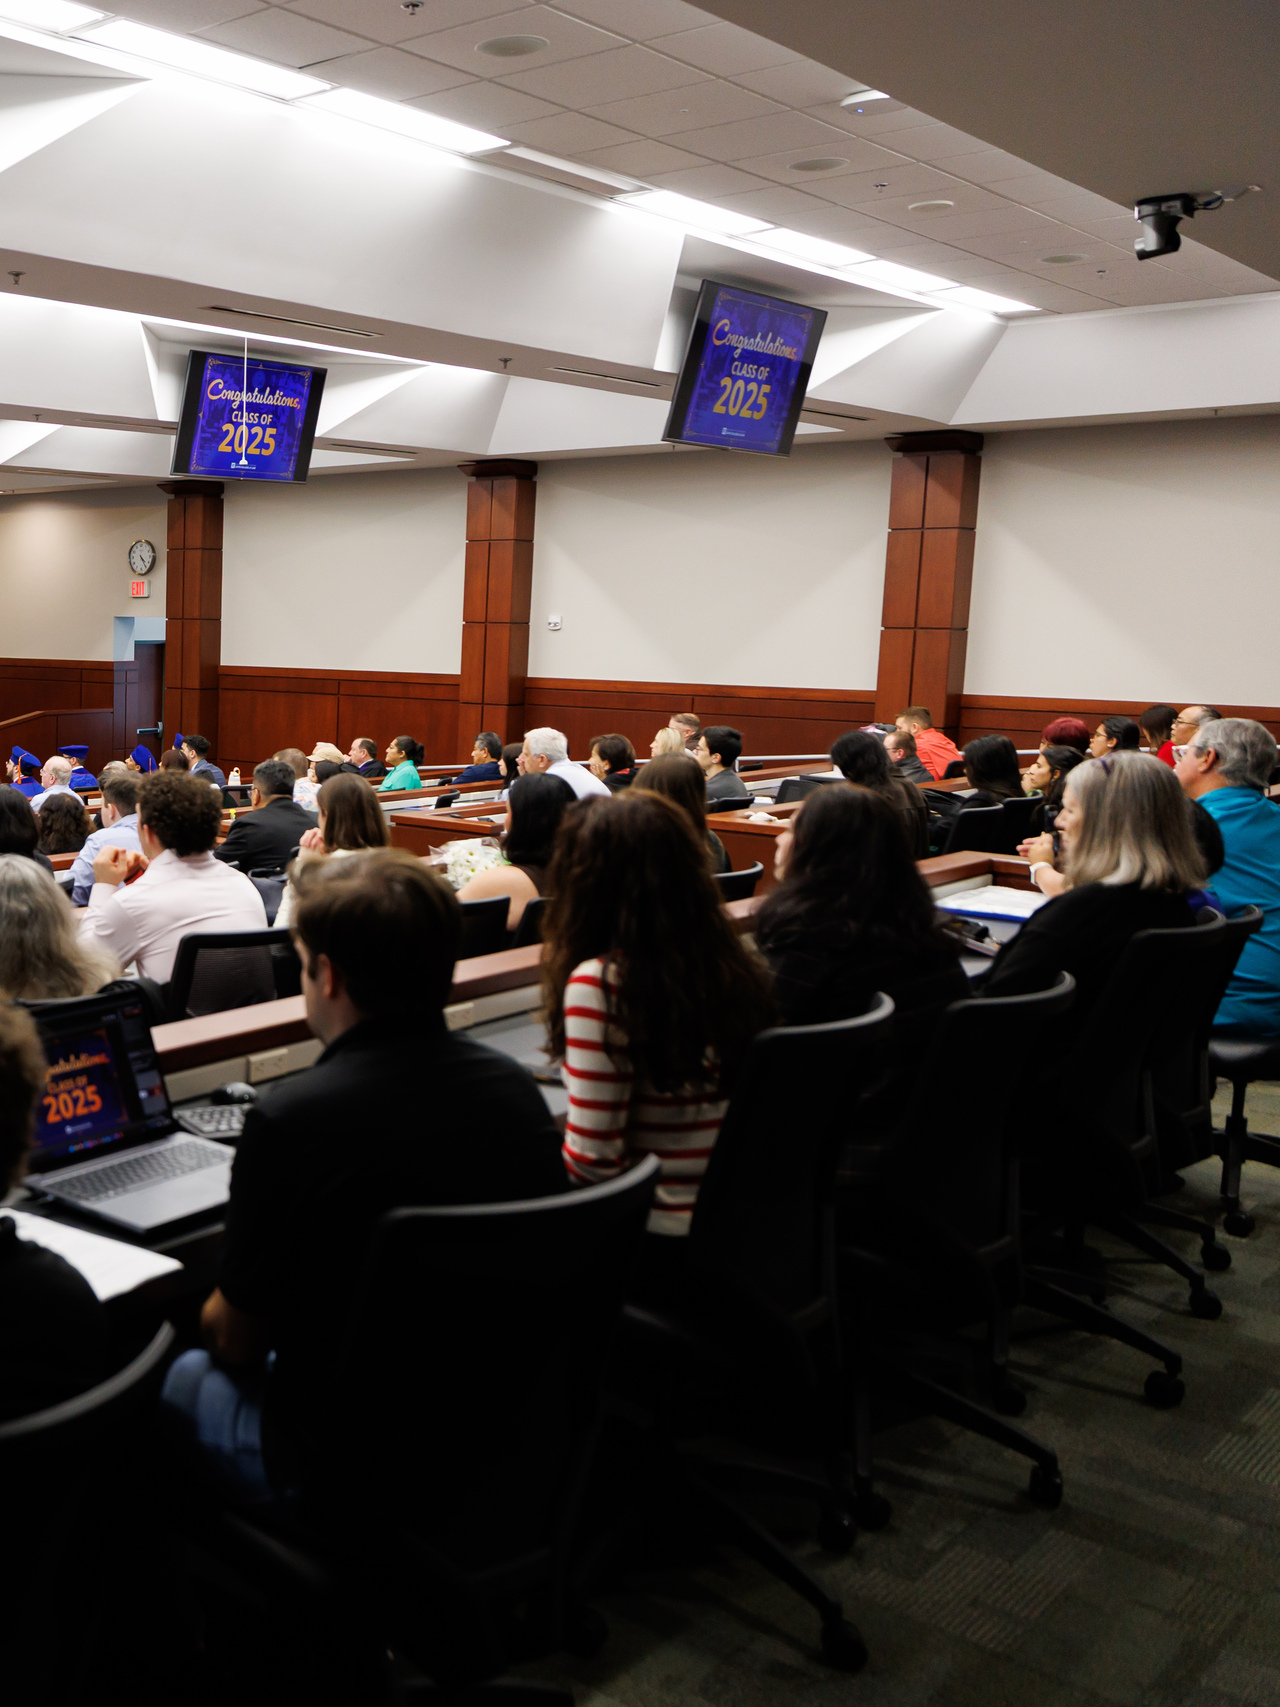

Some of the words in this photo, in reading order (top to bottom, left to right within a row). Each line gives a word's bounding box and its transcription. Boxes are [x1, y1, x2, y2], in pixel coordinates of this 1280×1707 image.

[713, 319, 797, 361] Congratulations,
[732, 361, 757, 379] CLASS
[758, 367, 770, 380] OF
[713, 377, 771, 420] 2025
[232, 410, 259, 424] CLASS
[260, 414, 273, 425] OF
[218, 423, 276, 456] 2025
[132, 581, 145, 596] EXIT
[42, 1084, 103, 1124] 2025
